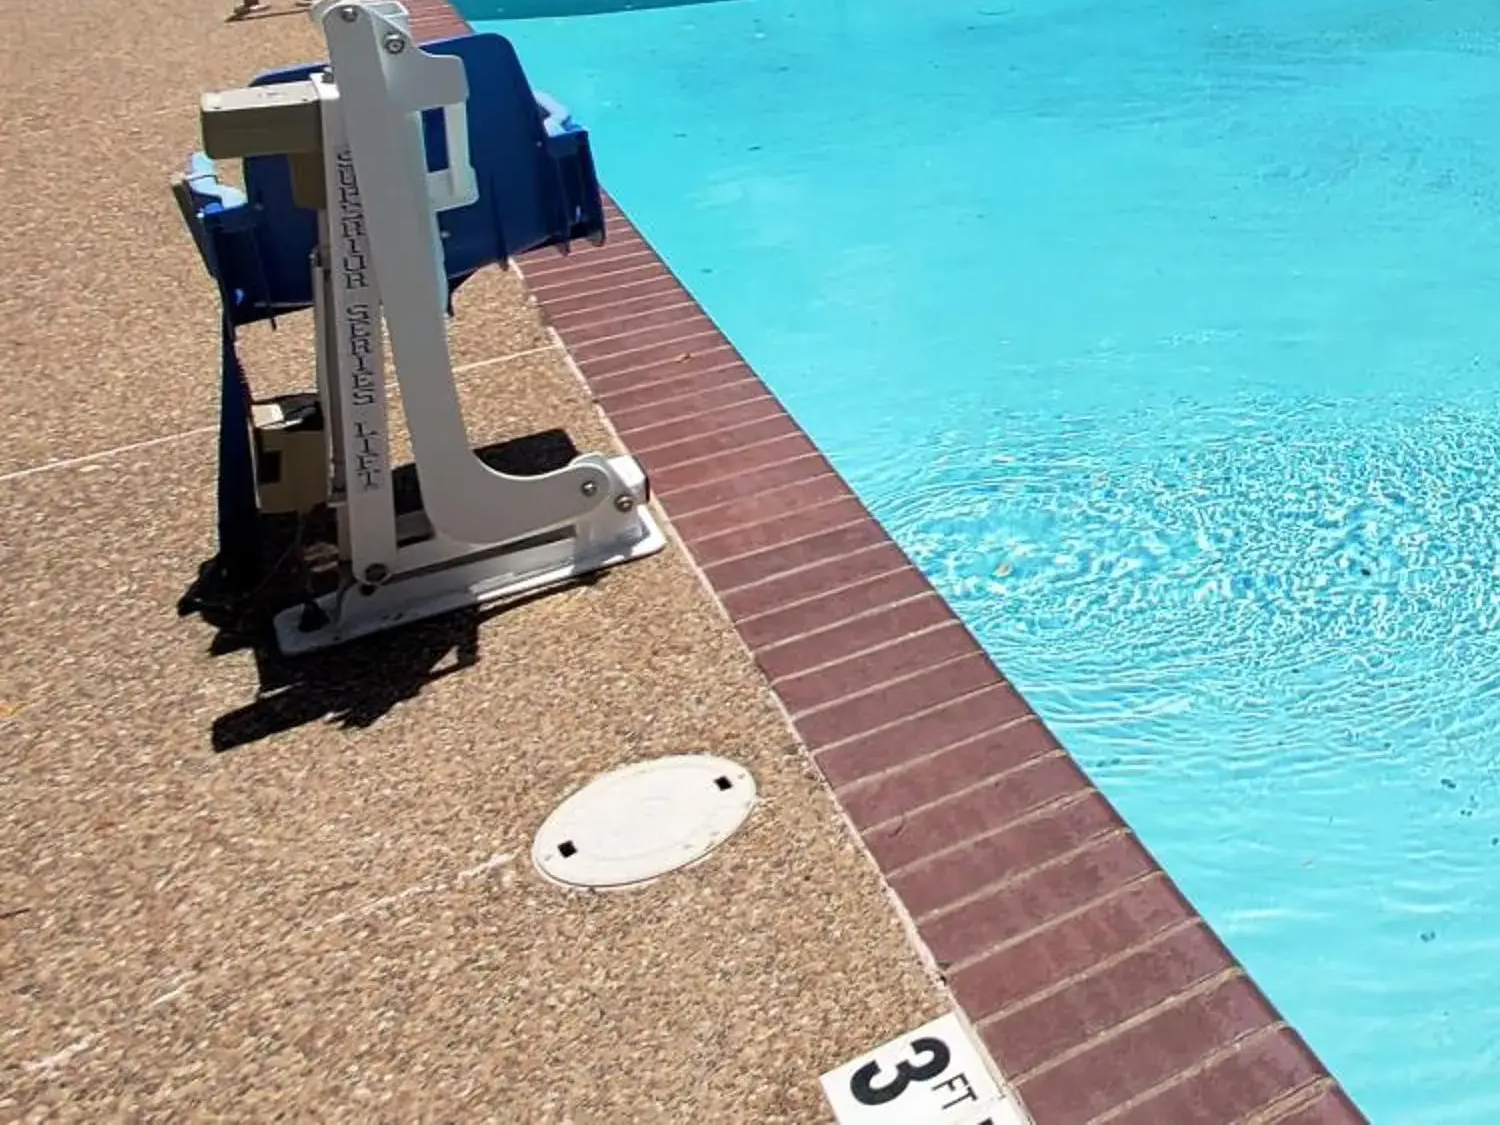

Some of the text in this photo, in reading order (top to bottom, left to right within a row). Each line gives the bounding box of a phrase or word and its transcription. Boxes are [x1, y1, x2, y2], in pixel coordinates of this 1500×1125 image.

[346, 304, 375, 406] SERIES
[354, 421, 382, 492] LIFT
[850, 1037, 978, 1110] 3 FT
